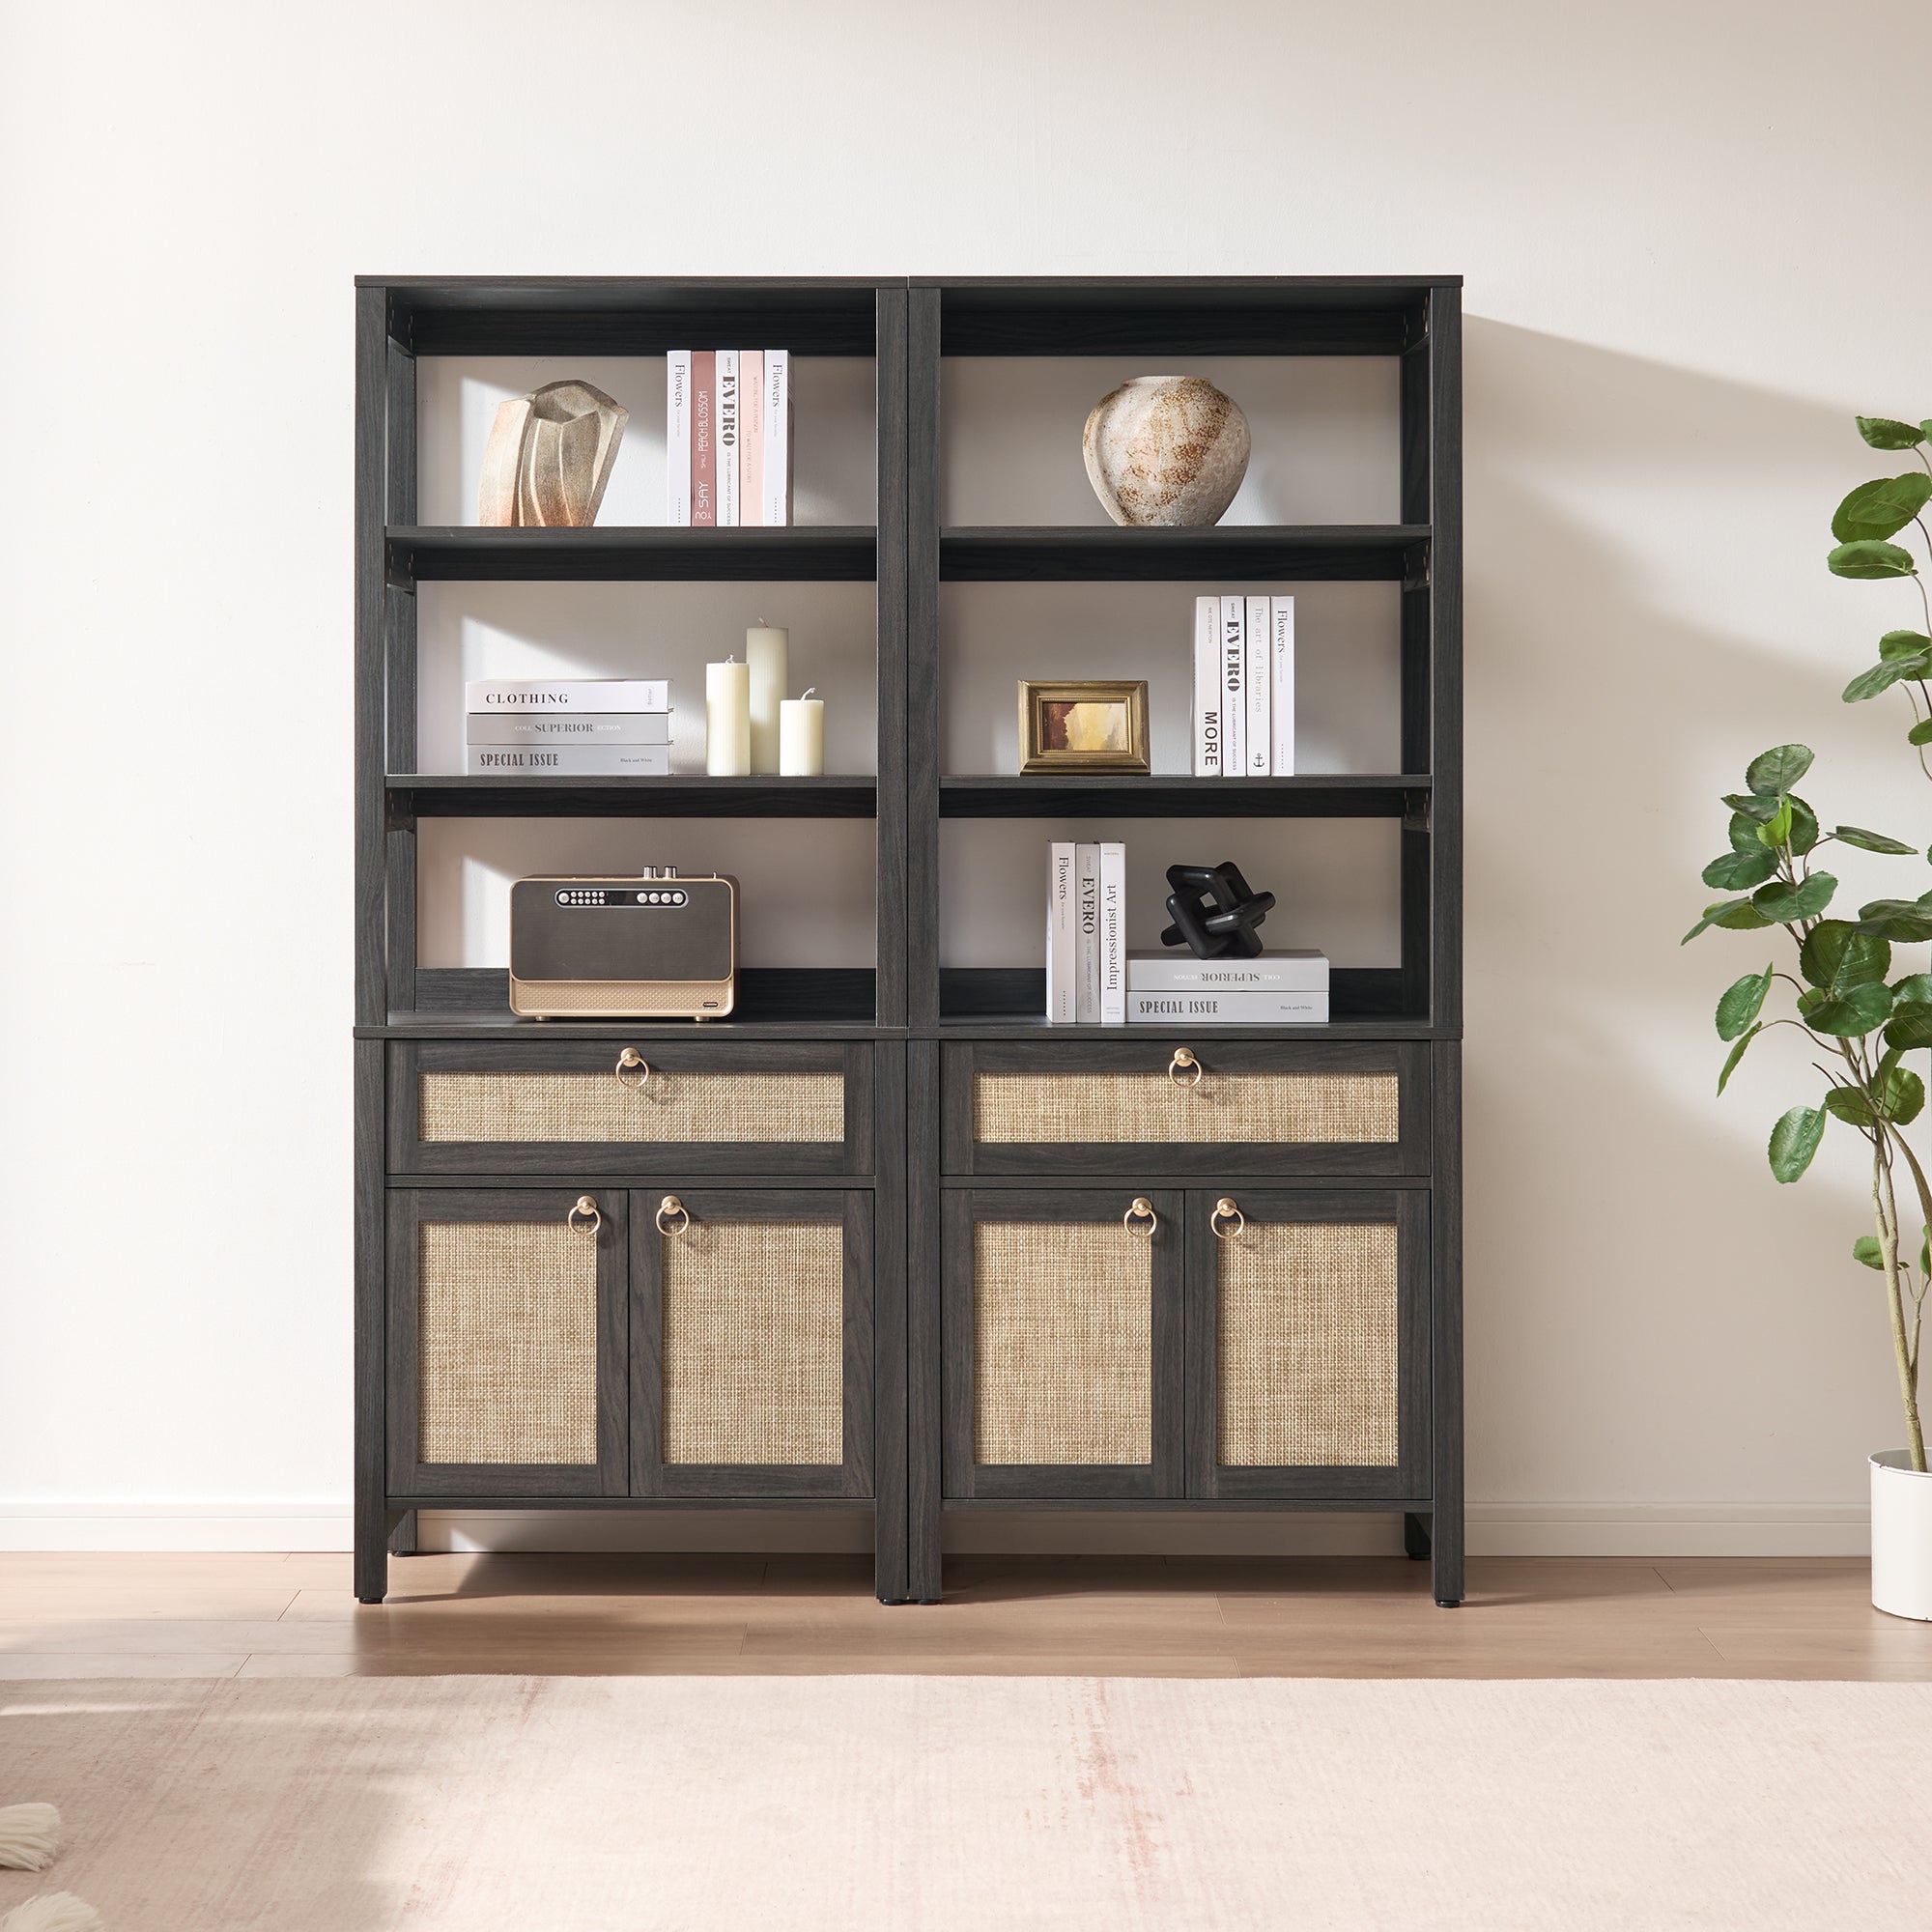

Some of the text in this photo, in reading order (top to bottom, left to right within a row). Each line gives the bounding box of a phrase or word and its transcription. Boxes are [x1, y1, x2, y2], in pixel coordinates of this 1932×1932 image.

[675, 364, 685, 407] Flowers
[772, 364, 782, 407] Flowers
[723, 376, 735, 446] EVERO
[698, 481, 709, 508] SAY
[1277, 611, 1288, 653] Flowers
[1227, 621, 1240, 692] EVERO
[1255, 607, 1264, 713] The art of libraries
[486, 693, 569, 704] CLOTHING
[534, 724, 594, 732] SUPERIOR
[1205, 712, 1217, 766] MORE
[480, 753, 558, 766] SPECIAL ISSUE
[1059, 857, 1069, 899] Flowers
[1082, 877, 1094, 934] EVERO
[1106, 885, 1120, 990] Impressionist Art
[1202, 973, 1261, 981] SUPERIOR
[1139, 1001, 1219, 1013] SPECIAL ISSUE
